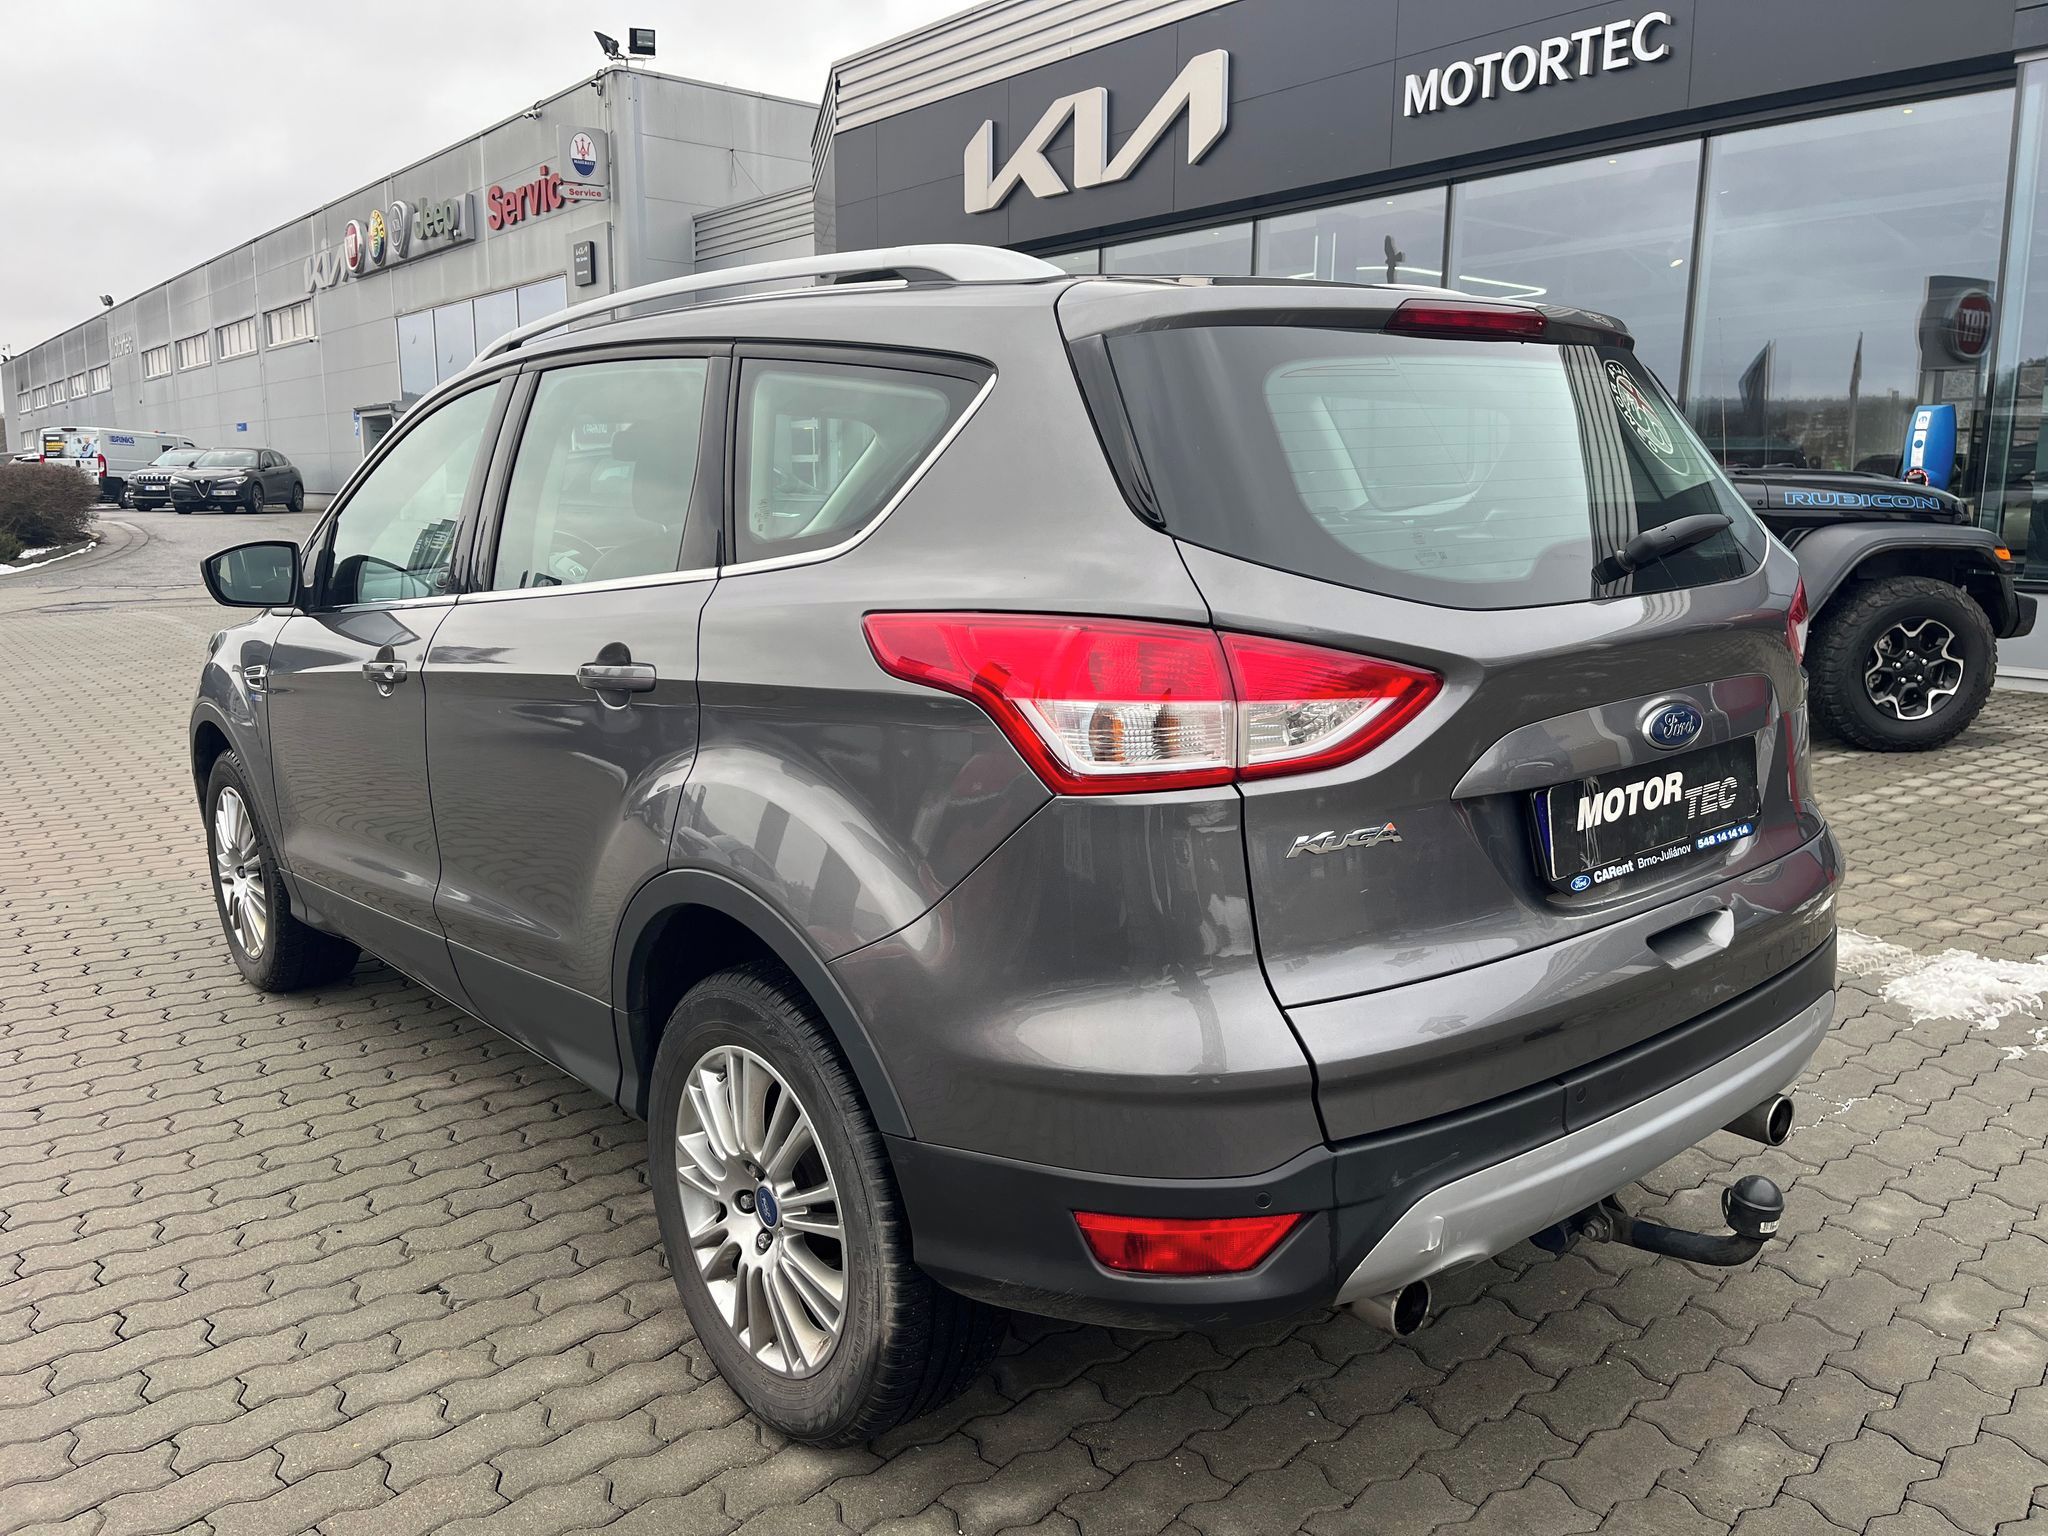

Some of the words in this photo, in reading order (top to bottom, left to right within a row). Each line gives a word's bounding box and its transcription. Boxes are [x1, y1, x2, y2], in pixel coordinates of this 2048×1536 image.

[1403, 11, 1672, 118] MOTORTEC
[488, 165, 578, 230] Servic
[569, 188, 602, 198] Service
[413, 197, 459, 240] Jeep
[1784, 491, 1940, 510] RUBICON
[1663, 712, 1695, 738] Ford
[1577, 771, 1683, 831] MOTOR
[1593, 860, 1634, 884] CARent
[1697, 835, 1715, 849] 548
